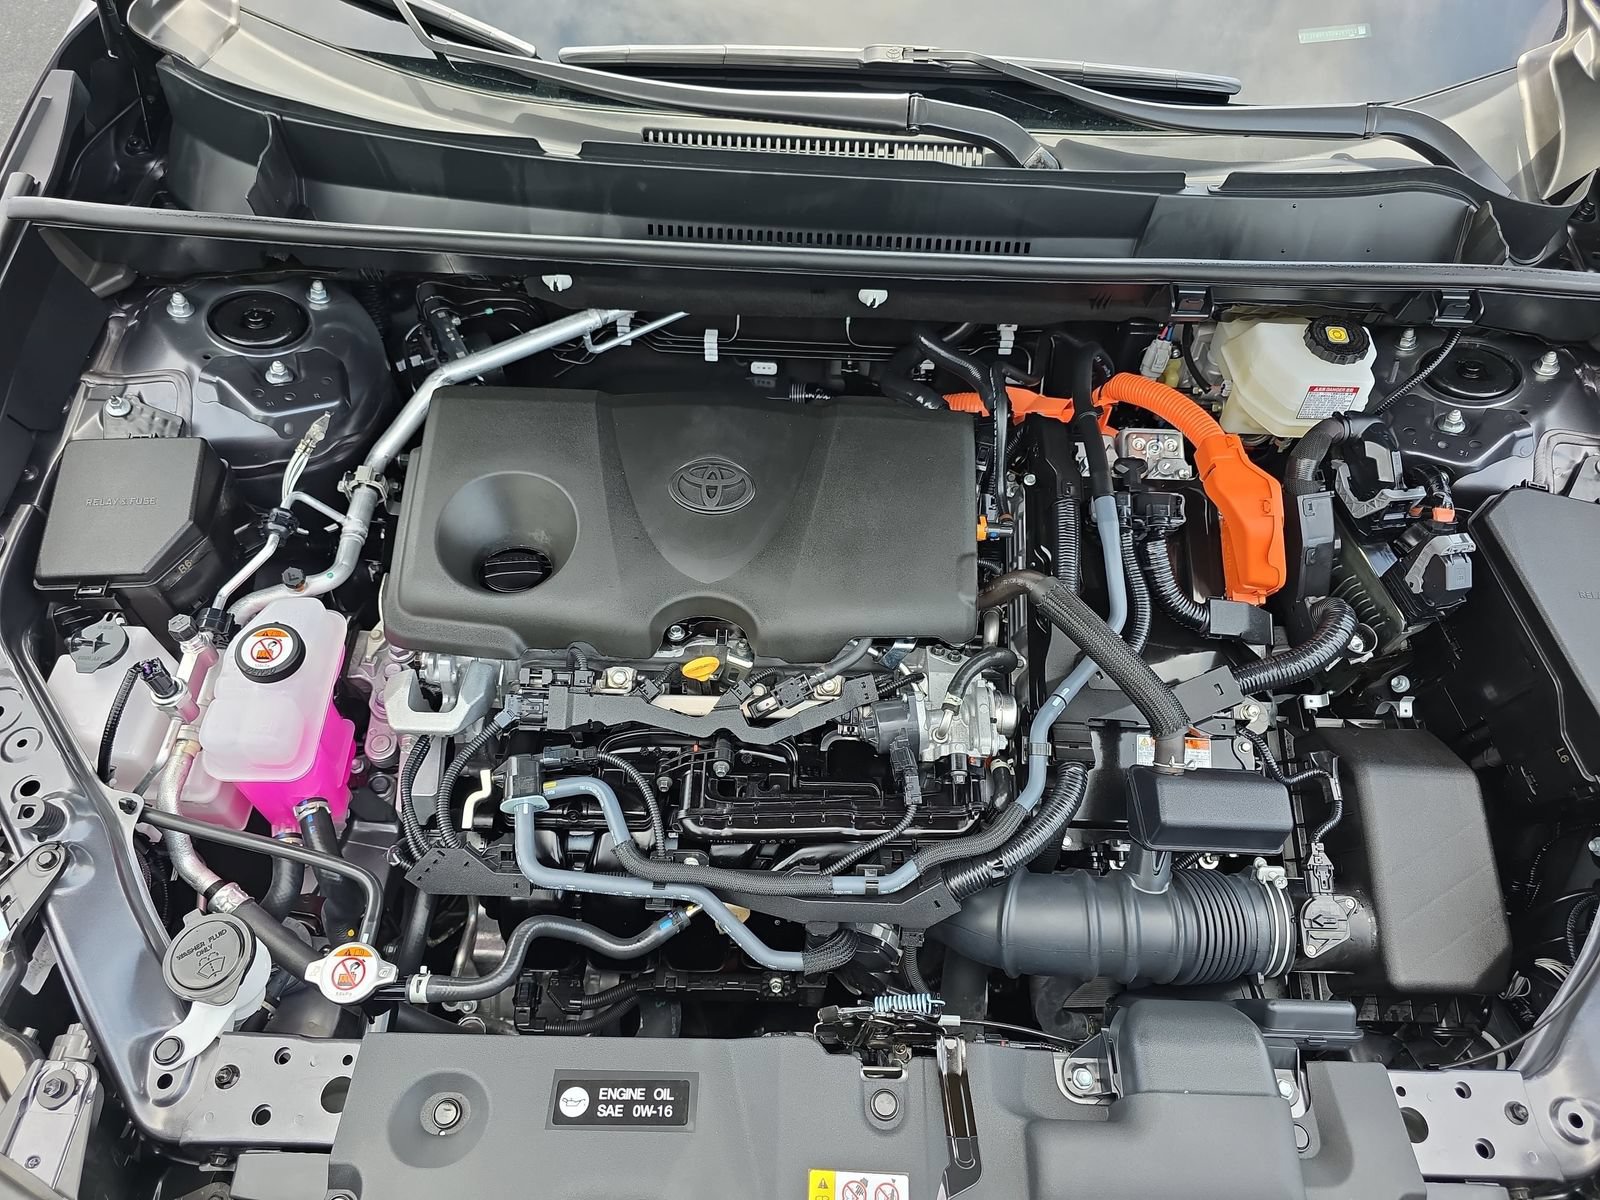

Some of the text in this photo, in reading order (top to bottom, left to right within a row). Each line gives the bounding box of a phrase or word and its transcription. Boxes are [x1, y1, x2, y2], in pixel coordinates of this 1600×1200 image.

[86, 496, 158, 507] RELAY & FUSE
[1556, 747, 1570, 764] L6
[176, 928, 228, 960] WASHER FLUID
[196, 943, 213, 957] ONLY
[598, 1087, 675, 1101] ENGINE OIL
[596, 1104, 673, 1118] SAE 0W-16
